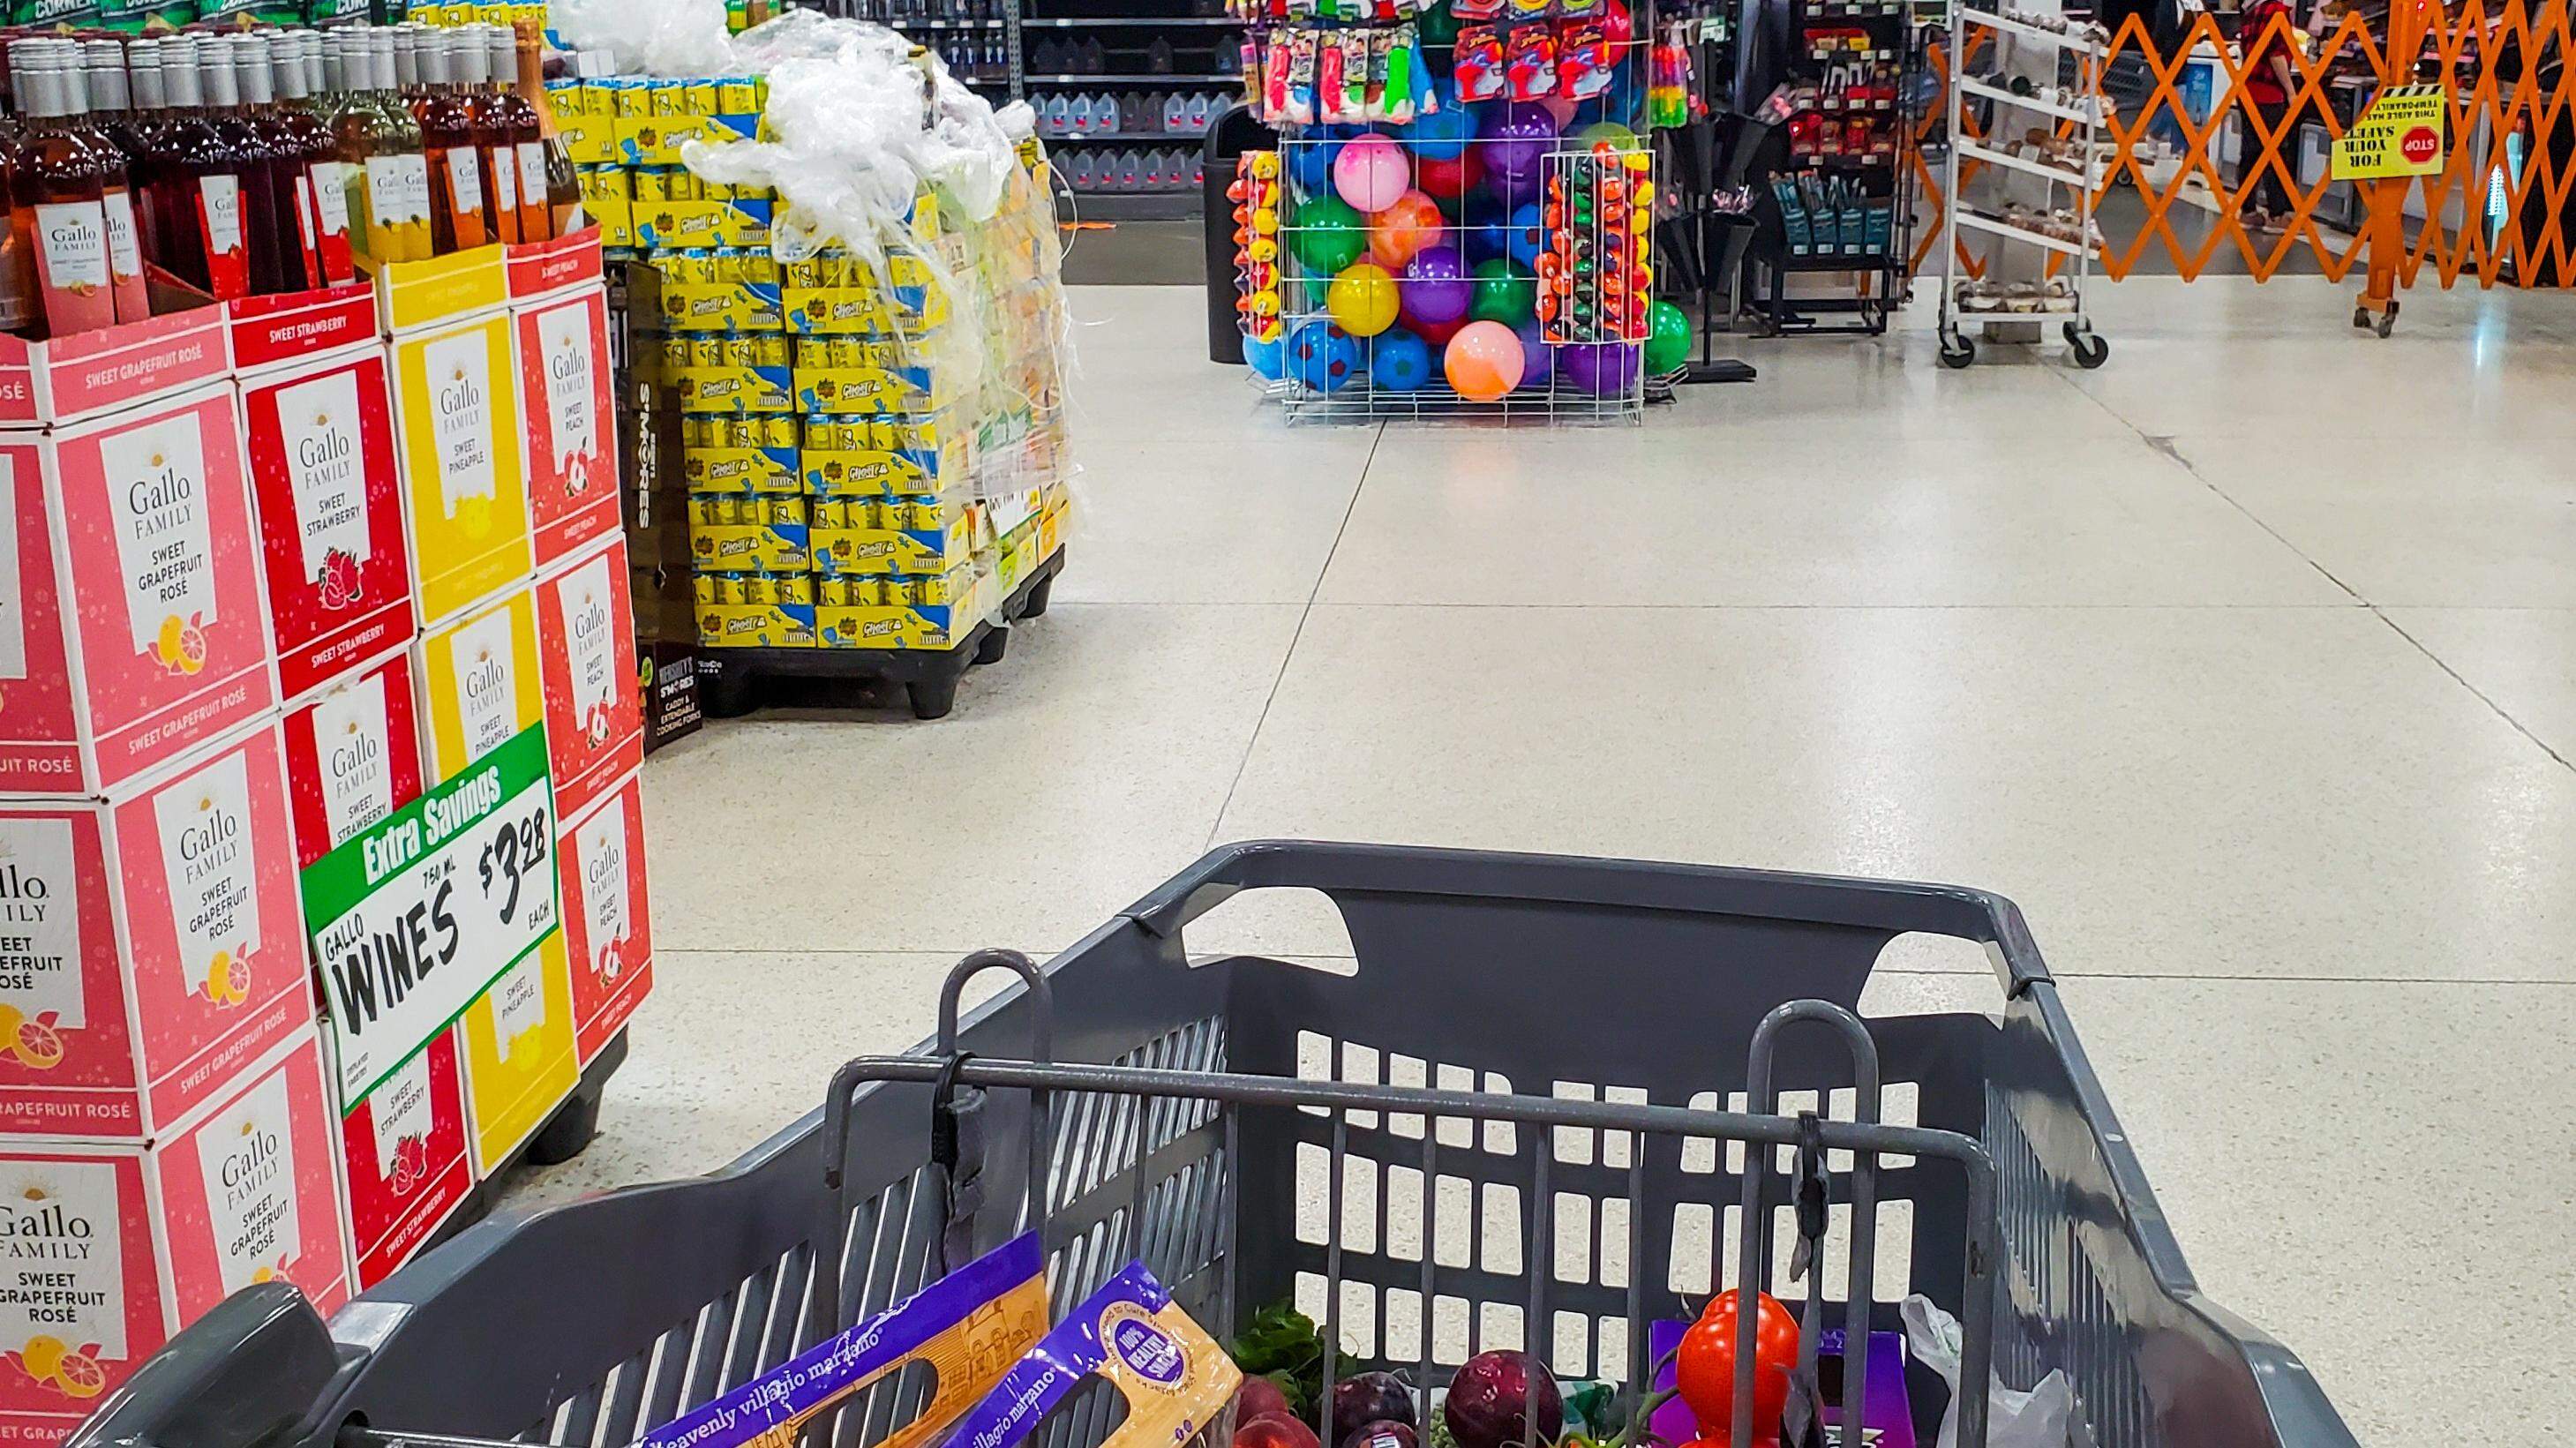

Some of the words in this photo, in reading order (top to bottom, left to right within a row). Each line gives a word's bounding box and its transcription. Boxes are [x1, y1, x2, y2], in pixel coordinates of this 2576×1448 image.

[2415, 109, 2436, 118] THIS
[2344, 139, 2386, 153] YOUR
[2347, 125, 2395, 139] SAFET
[2405, 139, 2435, 152] STOP
[2350, 154, 2381, 168] FOR
[51, 224, 96, 244] Gallo
[269, 326, 297, 343] SWEET
[297, 315, 348, 335] STRAWBERRY
[86, 373, 118, 389] SWEET
[120, 355, 176, 379] GRAPEFRUIT
[178, 343, 203, 364] ROSÉ
[552, 347, 585, 381] Gallo
[440, 378, 479, 416] Gallo
[556, 376, 586, 398] FAMILY
[444, 409, 480, 434] FAMILY
[565, 401, 583, 417] SWEET
[566, 415, 584, 432] PEACH
[299, 425, 350, 469] Gallo
[448, 450, 484, 476] PINEAPPLE
[454, 438, 477, 457] SWEET
[639, 382, 651, 529] S'MORES
[129, 467, 192, 515] Gallo
[304, 458, 351, 491] FAMILY
[319, 493, 346, 514] SWEET
[135, 502, 192, 541] FAMILY
[306, 504, 361, 537] STRAWBERRY
[151, 539, 186, 566] SWEET
[138, 553, 204, 591] GRAPEFRUIT
[160, 581, 189, 604] ROSÉ
[575, 604, 605, 640] Gallo
[312, 647, 337, 670] SWEET
[336, 623, 385, 656] STRAWBERRY
[579, 632, 605, 656] FAMILY
[466, 660, 505, 699] Gallo
[586, 653, 603, 673] SWEET
[587, 669, 605, 686] PEACH
[470, 687, 506, 717] FAMILY
[128, 726, 161, 755] SWEET
[162, 700, 222, 739] GRAPEFRUIT
[221, 686, 248, 709] ROSÉ
[480, 715, 501, 738] SWEET
[332, 732, 377, 770] Gallo
[475, 726, 510, 755] PINEAPPLE
[28, 755, 74, 774] ROSÉ
[336, 763, 378, 799] FAMILY
[337, 801, 387, 844] STRAWBERRY
[348, 794, 374, 818] SWEET
[180, 808, 237, 862] Gallo
[363, 815, 422, 887] Extra
[423, 764, 501, 847] Savings
[184, 839, 239, 886] FAMILY
[423, 865, 443, 890] 750
[443, 853, 457, 881] ML
[589, 844, 620, 884] Gallo
[0, 864, 47, 900] llo
[201, 876, 232, 908] SWEET
[591, 867, 620, 900] FAMILY
[6, 904, 47, 923] ILY
[189, 886, 249, 934] GRAPEFRUIT
[528, 900, 551, 933] EACH
[599, 893, 616, 916] SWEET
[208, 912, 236, 942] ROSÉ
[325, 912, 365, 963] GALLO
[0, 936, 33, 953] EET
[331, 879, 460, 1037] WINES
[0, 956, 64, 973] EFRUIT
[0, 972, 34, 990] OSÉ
[501, 984, 535, 1021] PINEAPPLE
[506, 976, 528, 1001] SWEET
[180, 1064, 211, 1095] SWEET
[212, 1027, 264, 1076] GRAPEFRUIT
[264, 1007, 288, 1033] ROSÉ
[0, 1101, 80, 1119] APEFRUIT
[86, 1100, 131, 1119] ROSÉ
[389, 1078, 413, 1110] SWEET
[380, 1085, 426, 1137] STRAWBERRY
[222, 1129, 278, 1189] Gallo
[227, 1155, 281, 1212] FAMILY
[229, 1198, 289, 1257] GRAPEFRUIT
[242, 1193, 274, 1229] SWEET
[386, 1232, 408, 1259] SWEET
[406, 1186, 447, 1236] STRAWBERRY
[248, 1227, 277, 1261] ROSÉ
[18, 1272, 77, 1288] SWEET
[28, 1305, 78, 1324] ROSÉ
[1118, 1324, 1146, 1351] 100%
[740, 1367, 806, 1419] villagio
[807, 1329, 880, 1378] marzano
[1010, 1371, 1056, 1421] marzano
